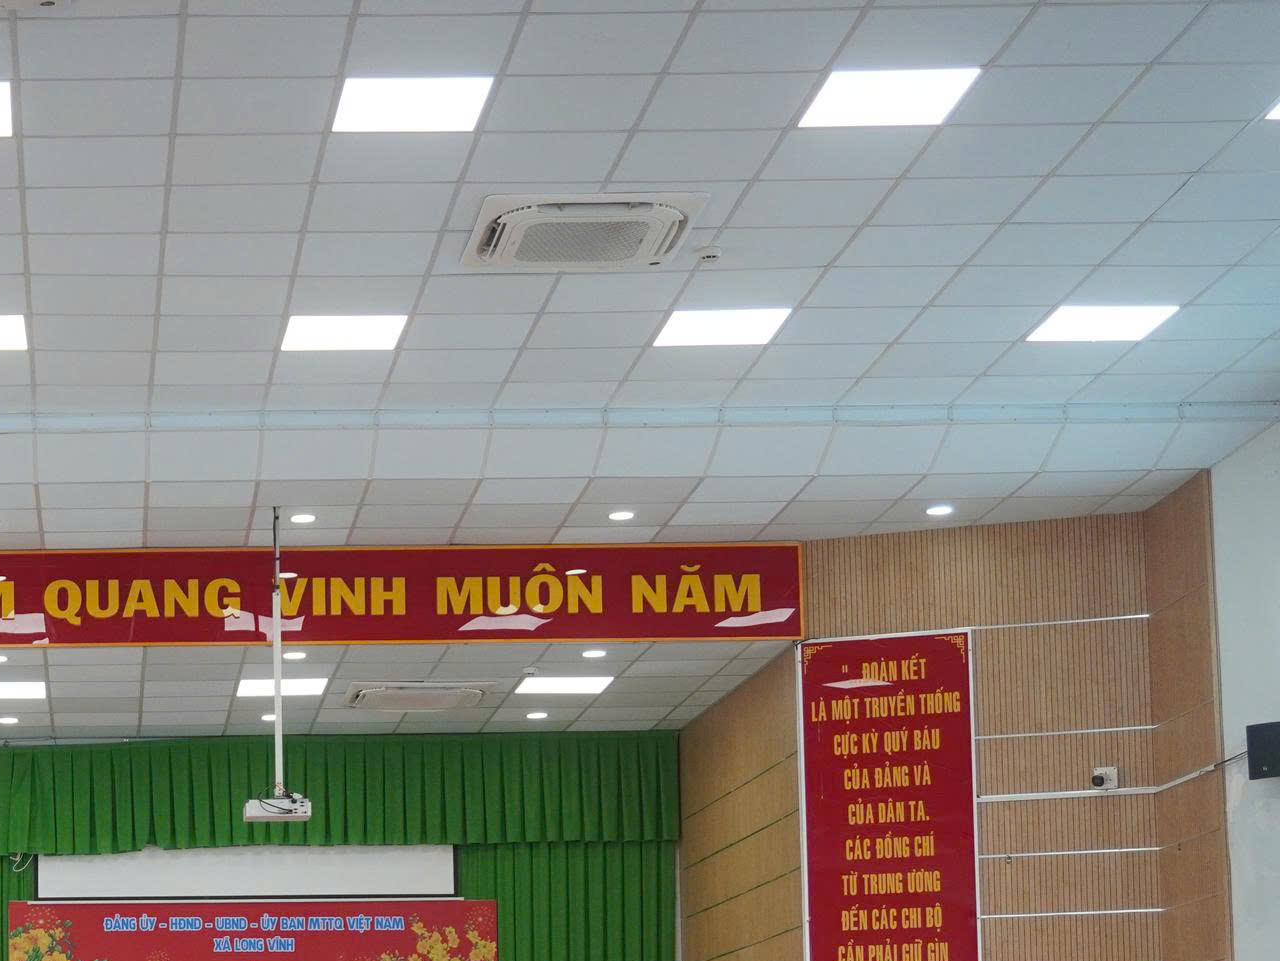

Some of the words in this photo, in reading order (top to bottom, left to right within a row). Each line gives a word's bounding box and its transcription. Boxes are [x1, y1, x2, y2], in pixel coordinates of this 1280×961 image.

[43, 578, 241, 626] QUANG
[272, 576, 407, 617] VINH
[436, 562, 603, 616] MUÔN
[631, 563, 762, 614] NĂM
[901, 653, 926, 680] KẾT
[811, 696, 827, 722] LÀ
[831, 695, 859, 724] MỘT
[864, 689, 915, 718] TRUYỀN
[919, 686, 961, 715] THỐNG
[833, 731, 858, 759] CỰC
[862, 728, 879, 754] KỲ
[884, 726, 909, 755] QUÝ
[913, 725, 940, 751] BÁU
[844, 762, 870, 790] CỦA
[874, 760, 910, 788] ĐẢNG
[913, 760, 931, 786] VÀ
[847, 797, 874, 825] CỦA
[878, 797, 905, 823] DÂN
[908, 800, 930, 822] TA.
[845, 835, 871, 861] CÁC
[875, 831, 910, 859] ĐỒNG
[914, 831, 935, 857] CHÍ
[842, 870, 858, 896] TỪ
[863, 872, 904, 895] TRUNG
[907, 868, 941, 893] ƯƠNG
[103, 913, 137, 931] ĐẢNG
[169, 916, 202, 931] HĐND
[215, 916, 248, 931] UBND
[260, 913, 278, 931] ỦY
[280, 916, 305, 931] BAN
[308, 916, 344, 931] MTTQ
[346, 913, 372, 933] VIỆT
[375, 916, 405, 931] NAM
[841, 903, 868, 931] ĐẾN
[871, 904, 897, 930] CÁC
[901, 907, 921, 929] CHI
[925, 902, 942, 932] BỘ
[234, 938, 264, 952] LONG
[267, 935, 295, 952] VĨNH
